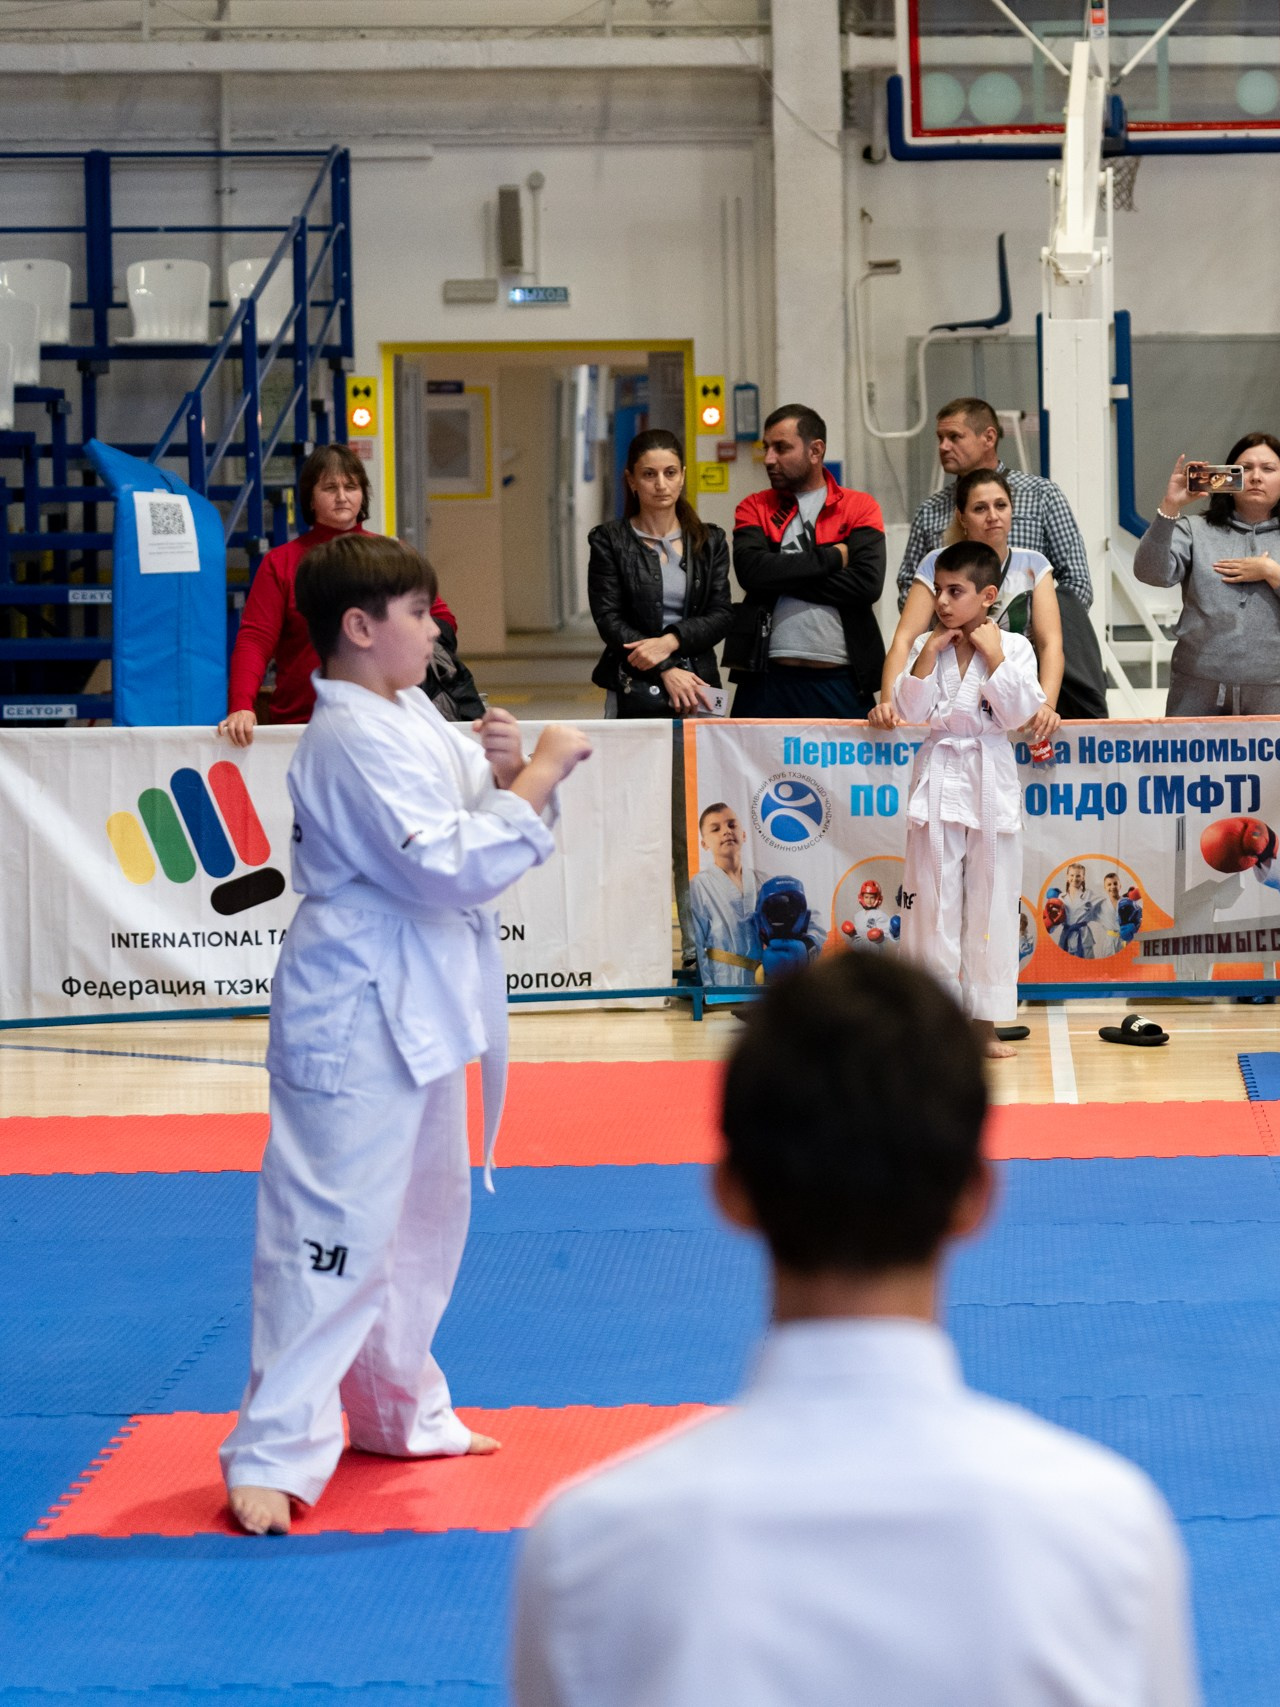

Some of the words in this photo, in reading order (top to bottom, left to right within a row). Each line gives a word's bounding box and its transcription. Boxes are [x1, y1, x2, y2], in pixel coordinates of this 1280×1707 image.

[72, 591, 113, 601] СЕКТО
[7, 706, 63, 716] СЕКТОР
[68, 706, 75, 716] 1
[784, 736, 925, 768] Первенст
[769, 772, 787, 783] КЛУБ
[788, 771, 827, 797] ТХЭКВОНДО
[1138, 774, 1261, 814] (МФТ)
[760, 833, 825, 852] НЕВИННОМЫССК
[111, 930, 263, 949] INTERNATIONAL
[61, 976, 206, 1000] Федерация
[506, 972, 592, 995] рополя
